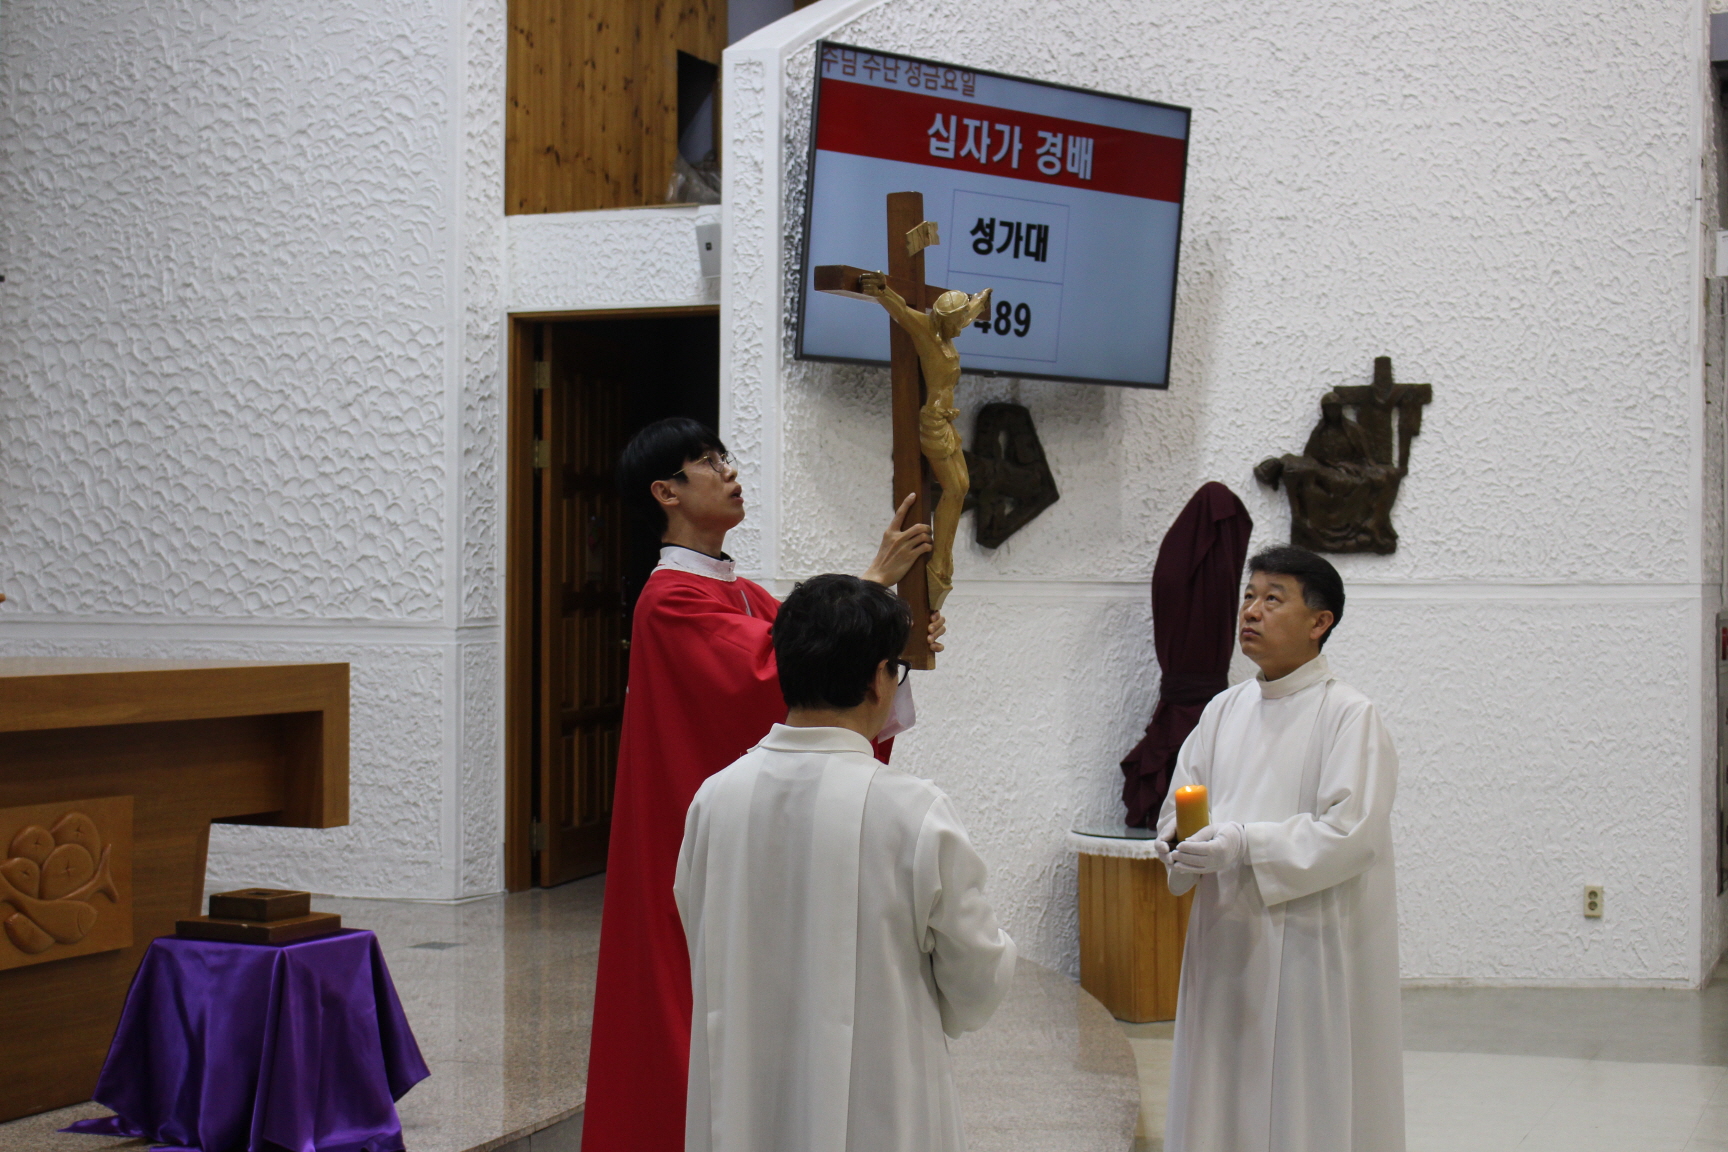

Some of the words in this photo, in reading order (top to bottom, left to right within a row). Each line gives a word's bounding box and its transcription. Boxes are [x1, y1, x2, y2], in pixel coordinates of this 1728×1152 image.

[822, 46, 857, 76] 주님
[863, 53, 901, 84] 수난
[904, 61, 976, 97] 성금요일
[927, 113, 1023, 169] 십자가
[1036, 130, 1094, 180] 경배
[969, 217, 1050, 263] 성가대
